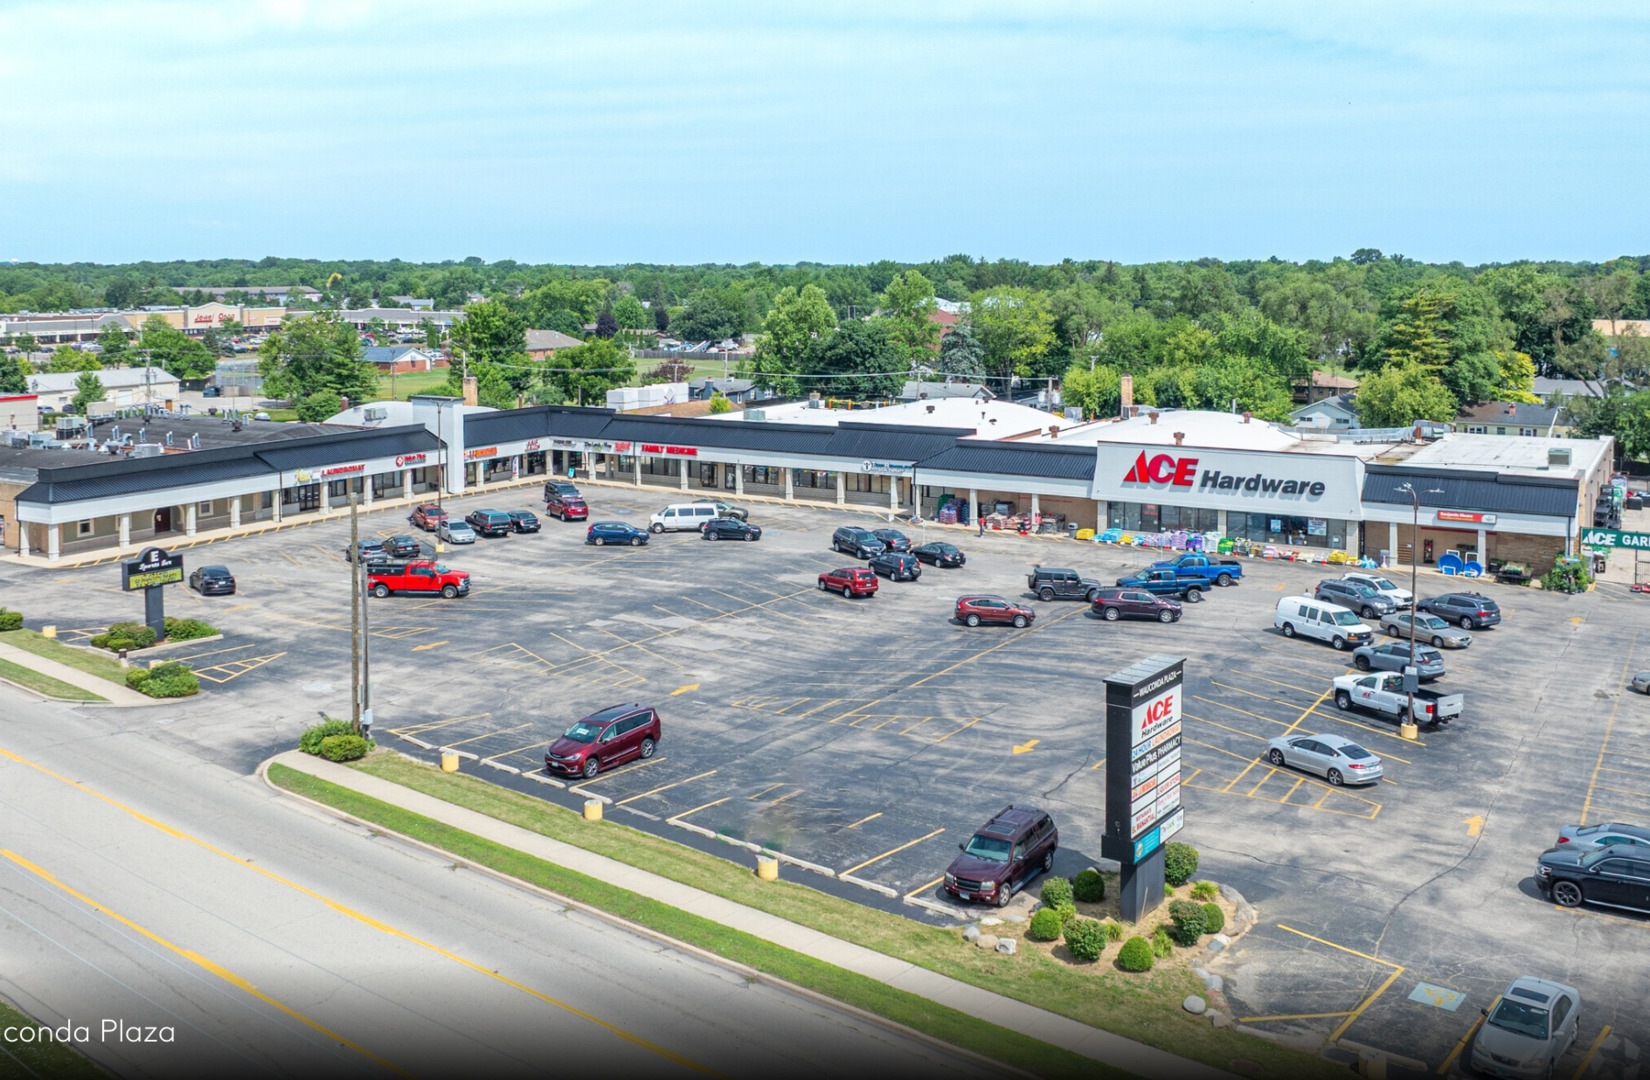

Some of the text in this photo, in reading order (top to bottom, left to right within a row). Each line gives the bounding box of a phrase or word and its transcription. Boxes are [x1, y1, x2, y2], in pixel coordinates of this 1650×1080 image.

[641, 444, 664, 453] FAMILY
[666, 446, 698, 456] MEDICINE
[321, 464, 366, 476] LAUNDROMAT
[1123, 450, 1325, 496] ACE Hardware
[1582, 530, 1650, 548] ACE GAR
[1141, 694, 1173, 729] ACE
[1141, 716, 1173, 738] Hardware
